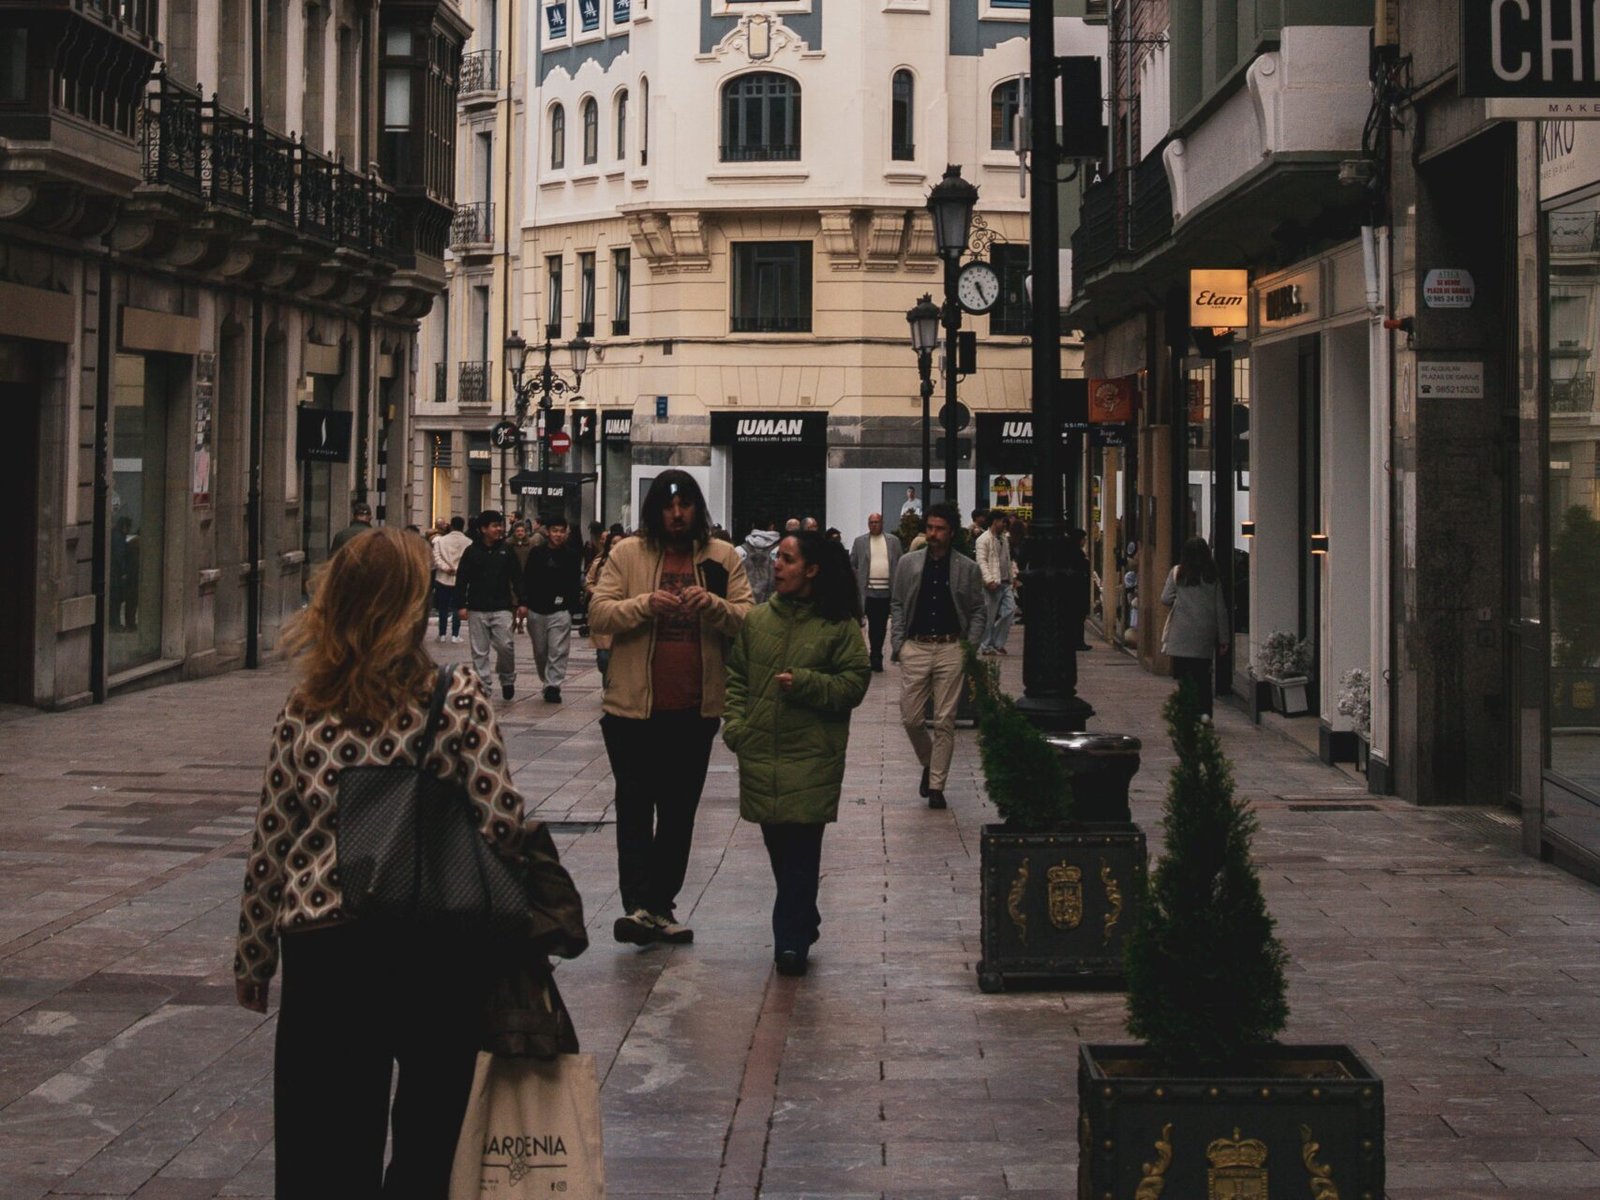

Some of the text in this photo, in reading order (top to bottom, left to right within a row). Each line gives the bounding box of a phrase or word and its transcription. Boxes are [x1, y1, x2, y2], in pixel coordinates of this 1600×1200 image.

[1549, 104, 1600, 112] MAKE
[1195, 289, 1242, 305] Etam
[736, 419, 803, 435] IUMAN
